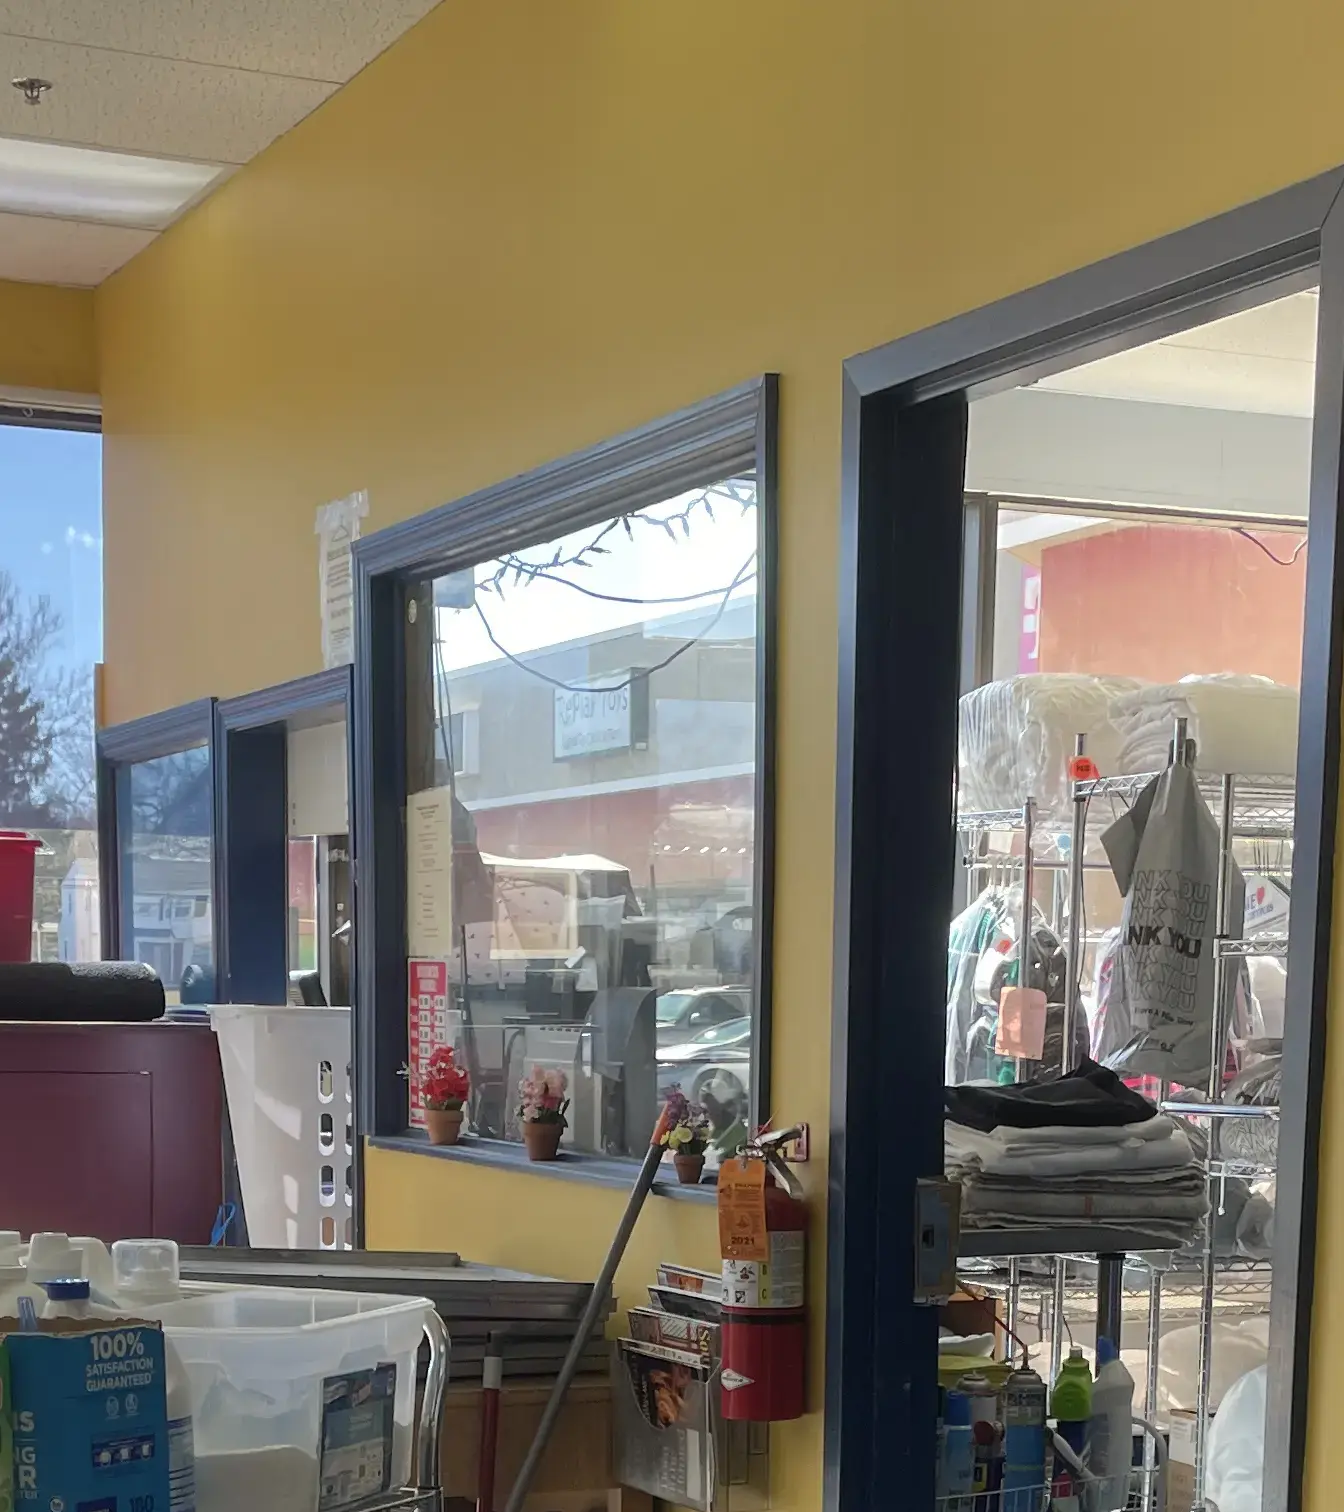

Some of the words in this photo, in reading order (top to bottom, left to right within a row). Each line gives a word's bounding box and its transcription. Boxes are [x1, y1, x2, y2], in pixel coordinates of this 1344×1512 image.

[731, 1236, 755, 1246] 2021
[89, 1331, 145, 1361] 100%
[85, 1357, 154, 1378] SATISFACTION
[86, 1372, 152, 1393] GUARANTEED
